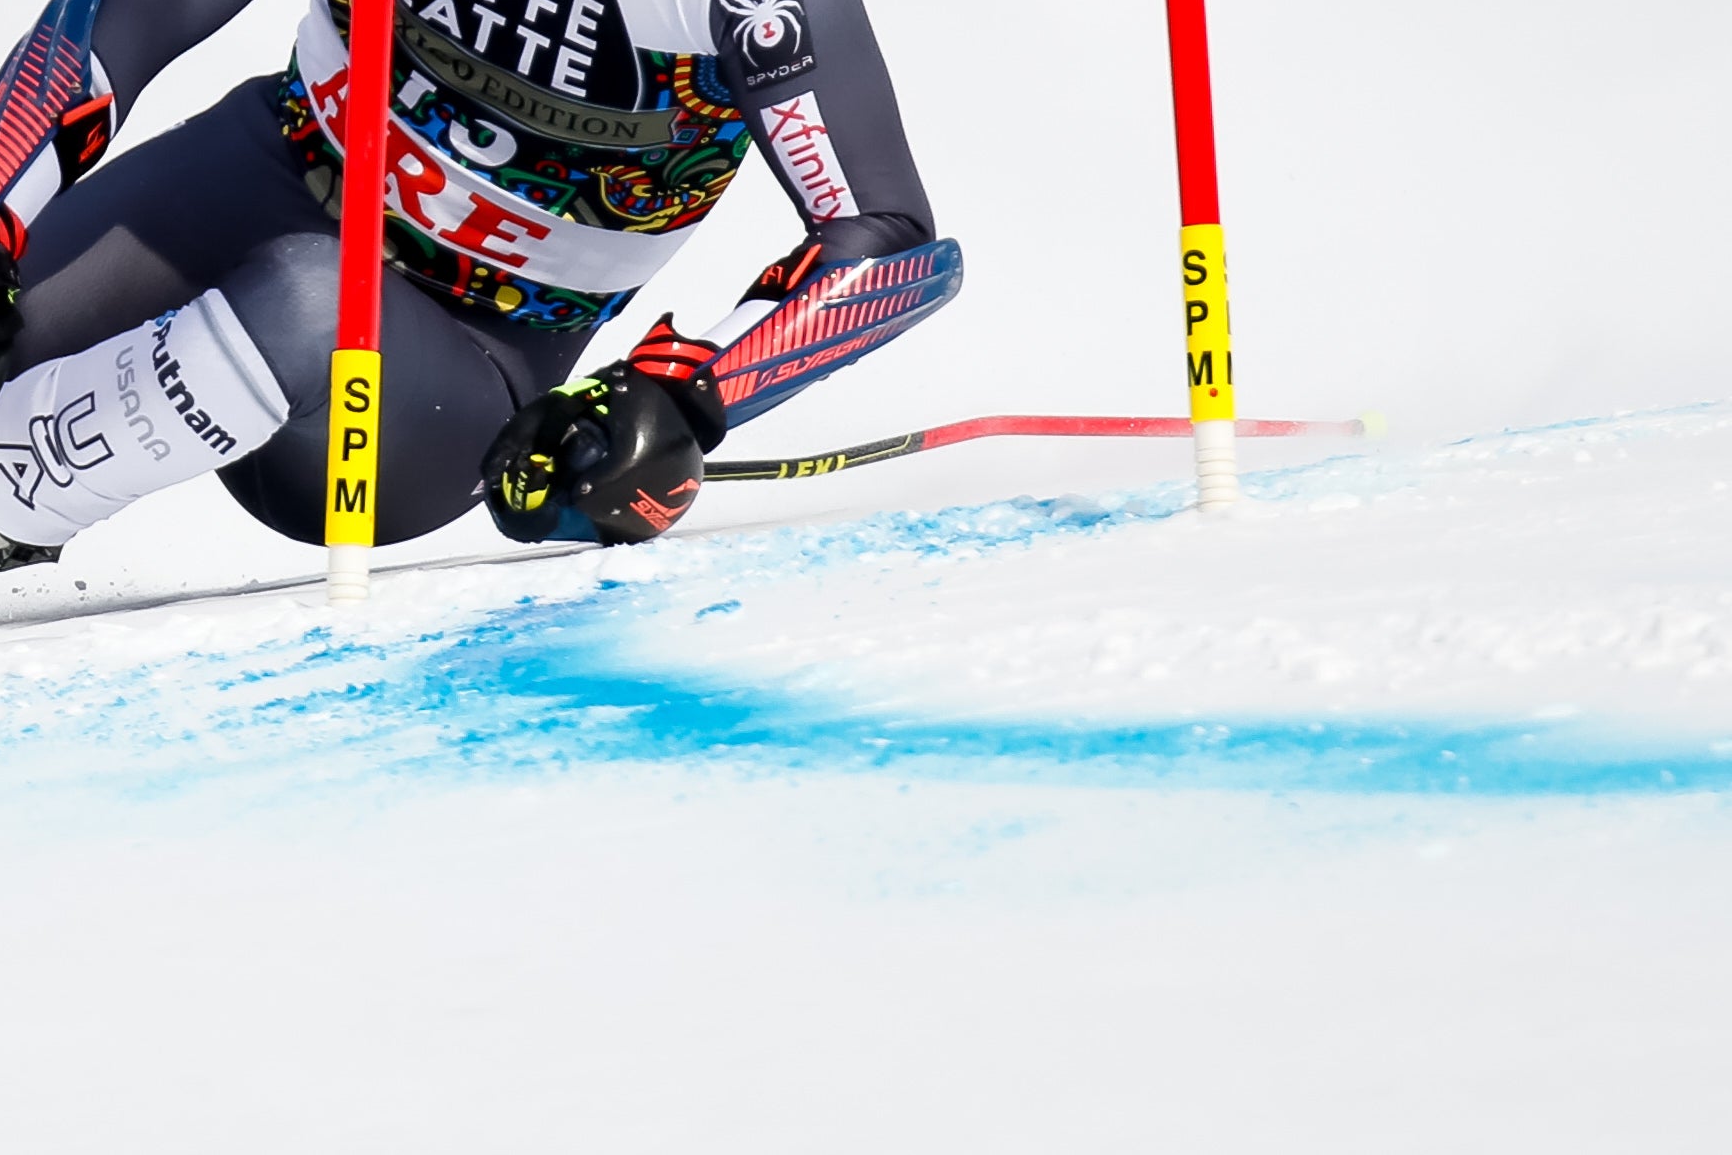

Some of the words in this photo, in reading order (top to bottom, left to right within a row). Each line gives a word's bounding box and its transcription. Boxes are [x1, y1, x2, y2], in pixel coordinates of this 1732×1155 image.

[481, 73, 643, 140] EDITION
[745, 54, 815, 87] SPYDER
[115, 345, 172, 462] USANA
[151, 321, 238, 456] Putnam
[334, 377, 371, 514] SPM
